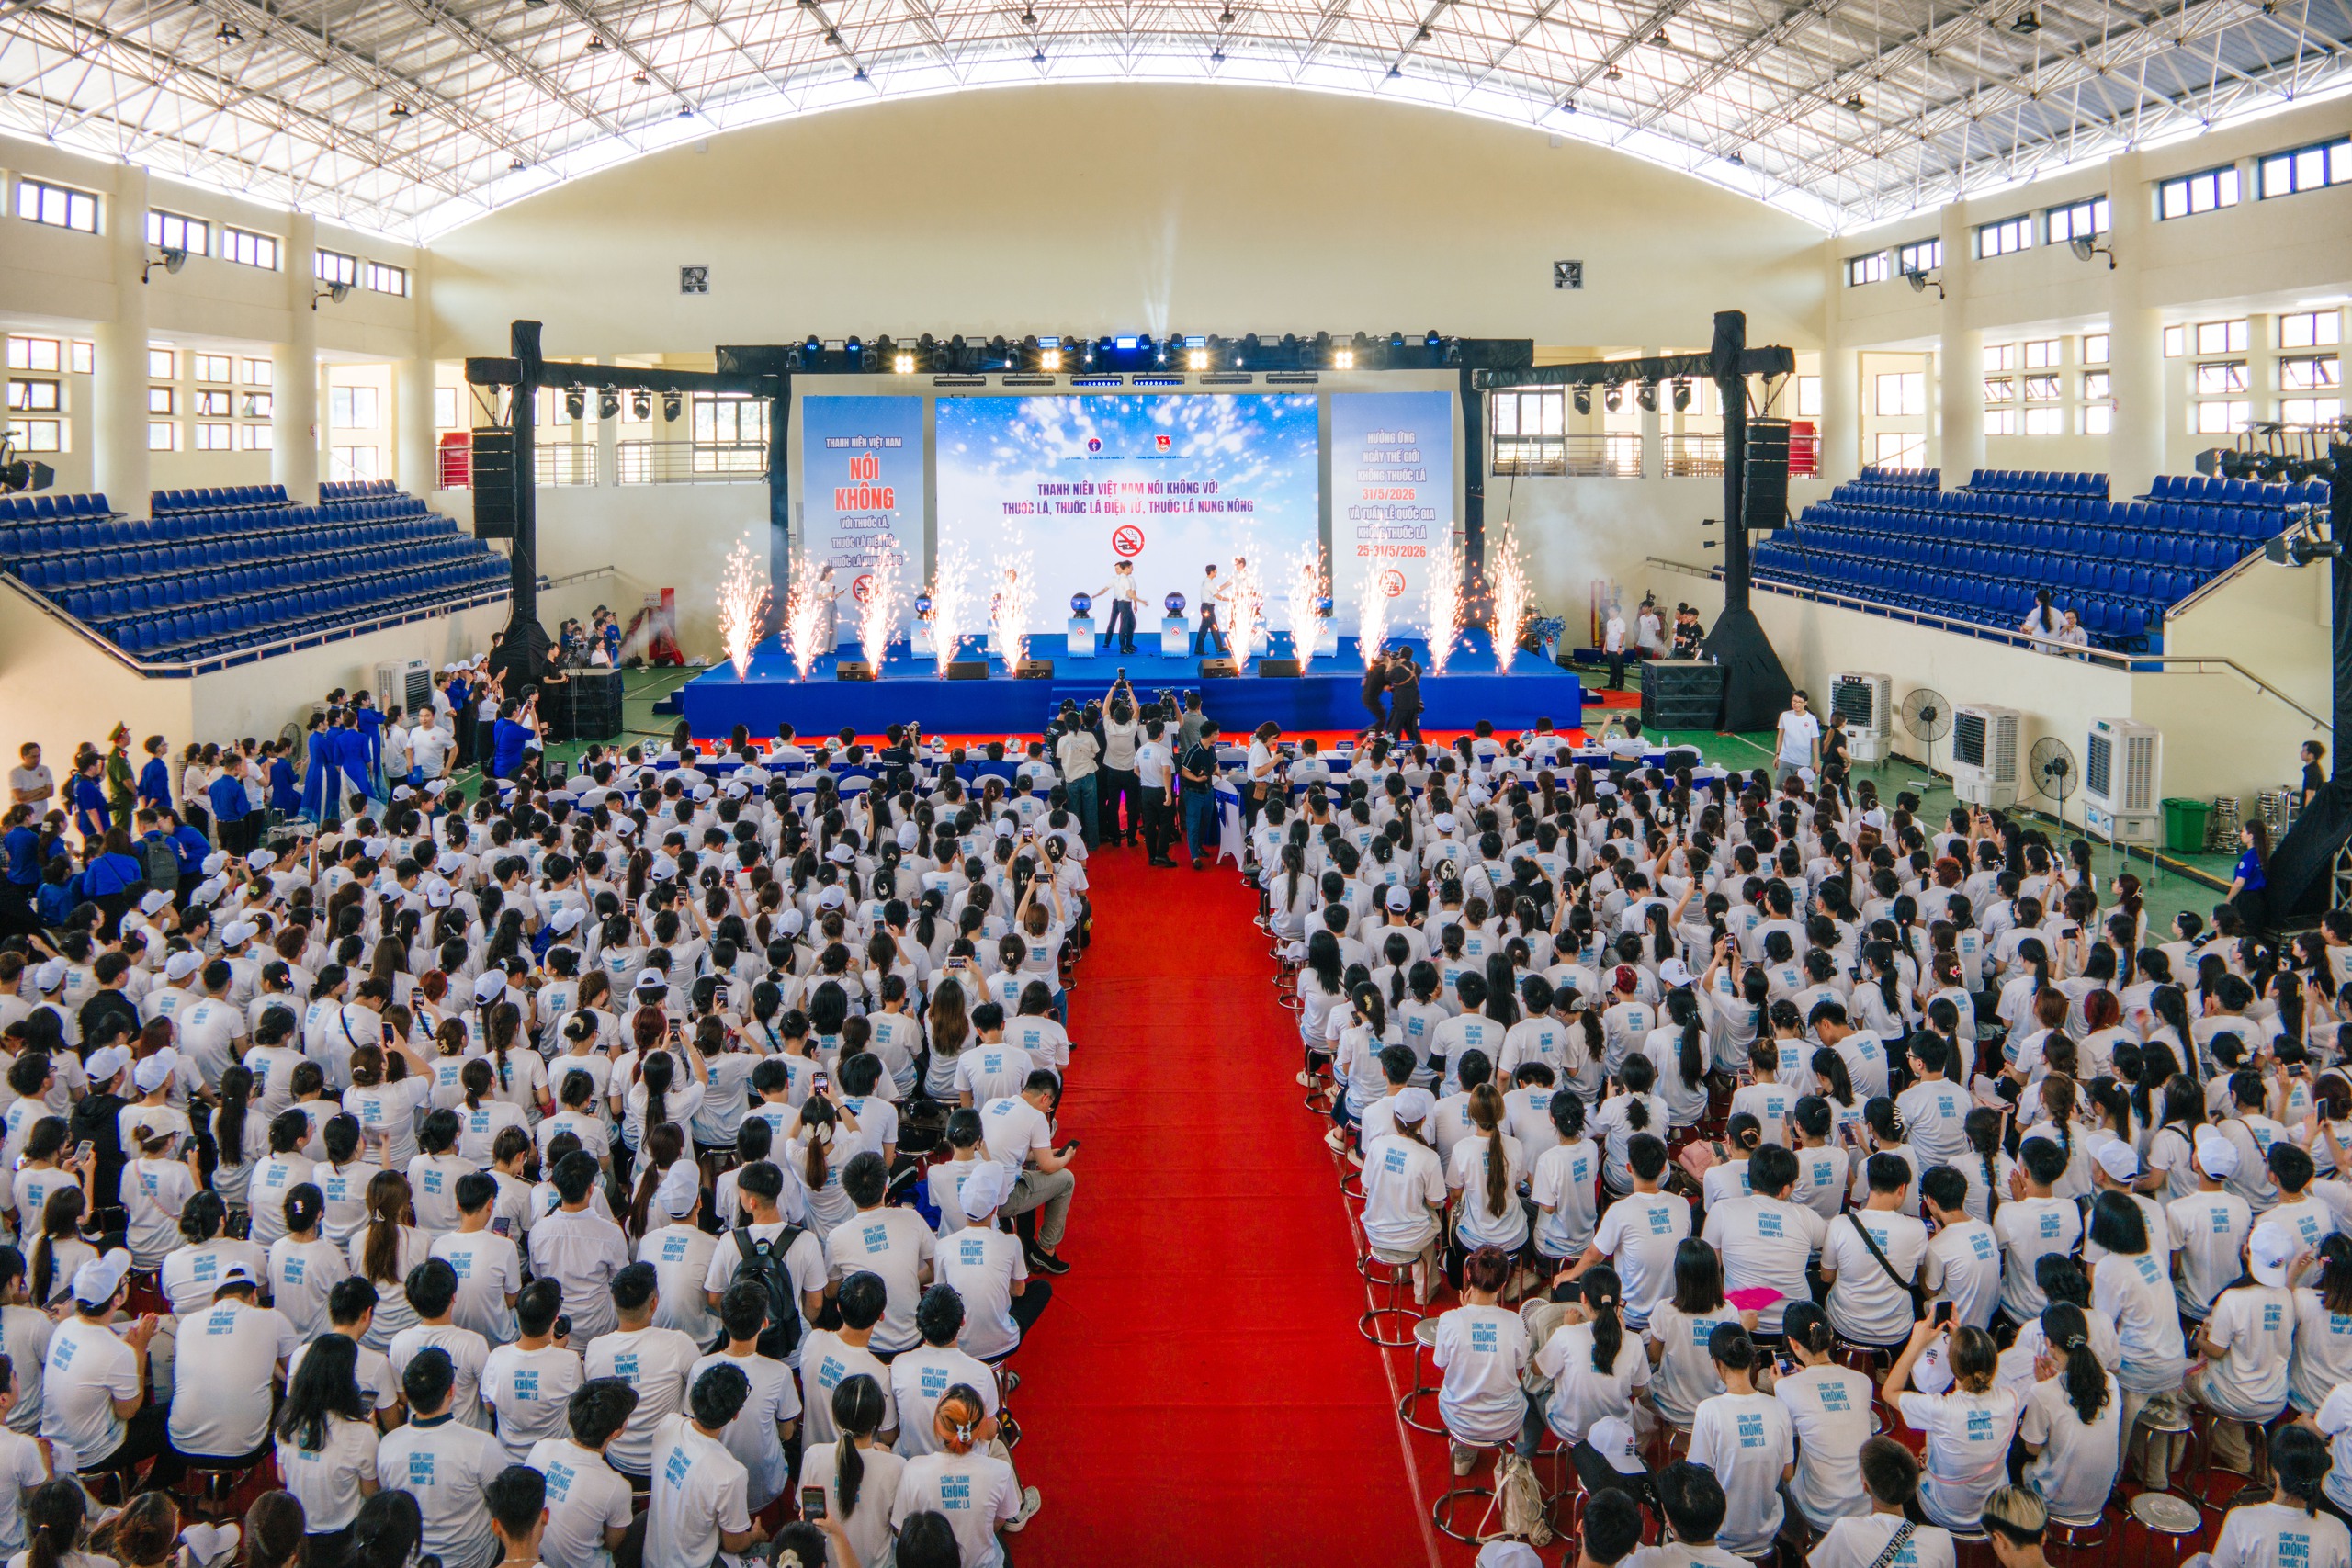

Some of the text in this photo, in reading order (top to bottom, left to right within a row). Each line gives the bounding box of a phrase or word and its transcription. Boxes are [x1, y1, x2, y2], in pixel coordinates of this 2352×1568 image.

[826, 435, 902, 449] THANH NIÊN VIỆT NAM
[1397, 431, 1416, 444] ỨNG
[1363, 448, 1420, 463] NGÀY THẾ GIỚI
[850, 452, 879, 480] NÓI
[1357, 468, 1427, 482] KHÔNG THUỐC LÁ
[1037, 484, 1069, 496] THANH
[1073, 480, 1094, 496] NIÊN
[1098, 480, 1118, 498] VIỆT
[1122, 483, 1144, 495] NAM
[1148, 479, 1164, 494] NÓI
[1167, 479, 1200, 494] KHÔNG
[1363, 488, 1415, 501] 31/5/2026
[835, 481, 895, 511] KHÔNG
[1002, 500, 1035, 514] THUỐC
[1037, 499, 1052, 515] LÁ,
[1056, 499, 1087, 514] THUỐC
[1090, 499, 1102, 513] LÁ
[1104, 498, 1126, 516] ĐIỆN
[1148, 498, 1181, 513] THUỐC
[1182, 498, 1194, 513] LÁ
[1198, 501, 1224, 513] NUNG
[1227, 498, 1254, 513] NÓNG
[1349, 505, 1361, 520] VÀ
[1385, 504, 1395, 520] LỄ
[1396, 505, 1419, 521] QUỐC
[1420, 508, 1435, 520] GIA
[841, 515, 890, 529] VỚI THUỐC LÁ,
[1357, 524, 1427, 539] KHÔNG THUỐC LÁ
[831, 535, 855, 548] THUỐC
[856, 535, 866, 547] LÁ
[1357, 545, 1427, 558] 25-31/5/2026
[828, 554, 852, 568] THUỐC
[852, 554, 862, 567] LÁ
[1758, 1218, 1782, 1230] KHÔNG
[960, 1245, 983, 1257] KHÔNG
[1472, 1329, 1497, 1342] KHÔNG
[1489, 1343, 1497, 1352] LÁ
[615, 1361, 639, 1374] KHÔNG
[514, 1377, 537, 1391] KHÔNG
[921, 1374, 946, 1389] KHÔNG
[1820, 1389, 1847, 1402] KHÔNG
[1843, 1401, 1851, 1411] LÁ
[1738, 1422, 1763, 1437] KHÔNG
[1758, 1436, 1766, 1447] LÁ
[955, 1476, 970, 1484] XANH
[940, 1483, 969, 1498] KHÔNG
[942, 1498, 970, 1510] THUỐC LÁ
[2278, 1540, 2309, 1559] KHÔNG
[2299, 1559, 2309, 1568] LÁ
